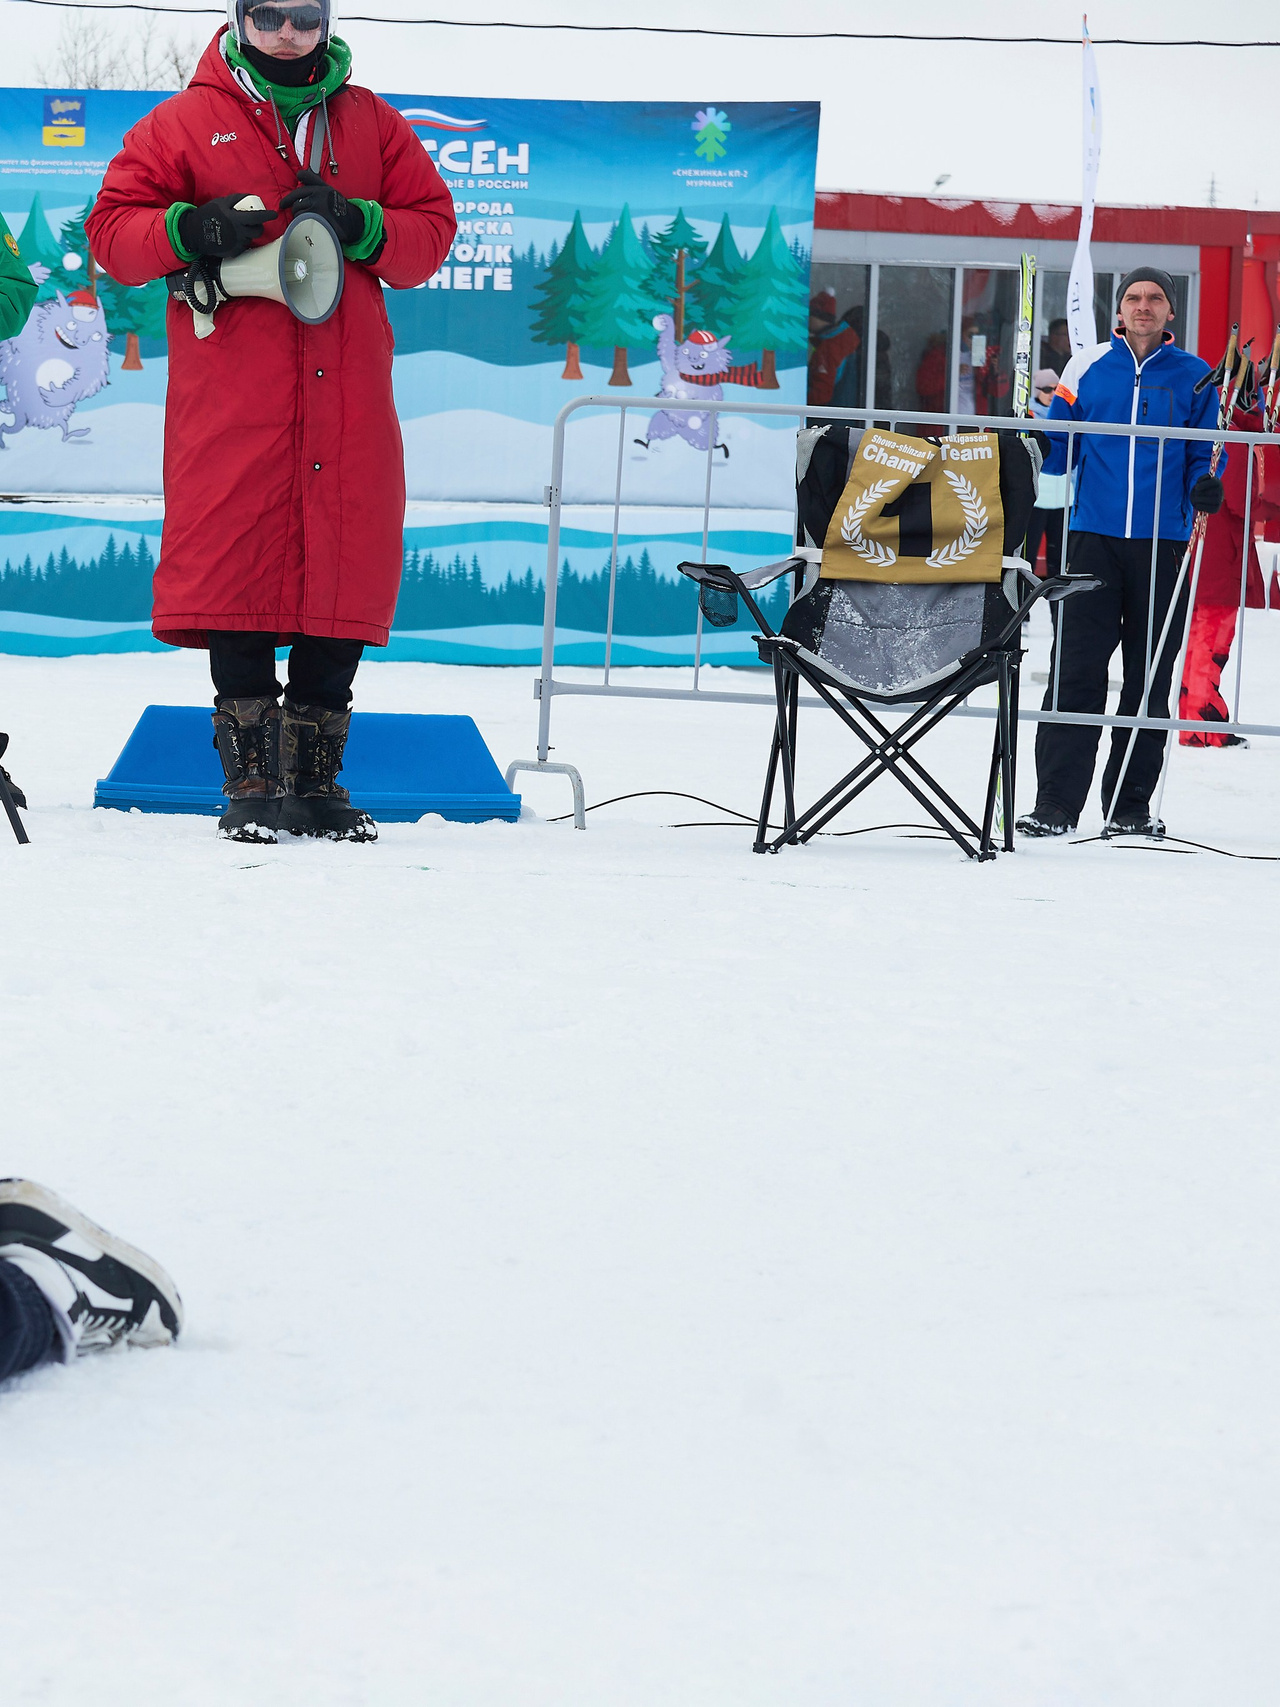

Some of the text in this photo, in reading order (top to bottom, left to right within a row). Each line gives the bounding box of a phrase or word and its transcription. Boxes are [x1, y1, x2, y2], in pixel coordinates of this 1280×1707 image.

[219, 131, 237, 143] asics
[30, 159, 73, 167] физической
[1, 167, 57, 175] администрации
[672, 168, 749, 178] «СНЕЖИНКА» КП-2
[467, 179, 475, 189] В
[477, 179, 529, 190] РОССИИ
[685, 180, 734, 188] МУРМАНСК
[413, 266, 513, 291] НЕГЕ
[871, 434, 926, 459] Showa-shinzan
[940, 443, 993, 462] Team
[880, 481, 933, 558] 1
